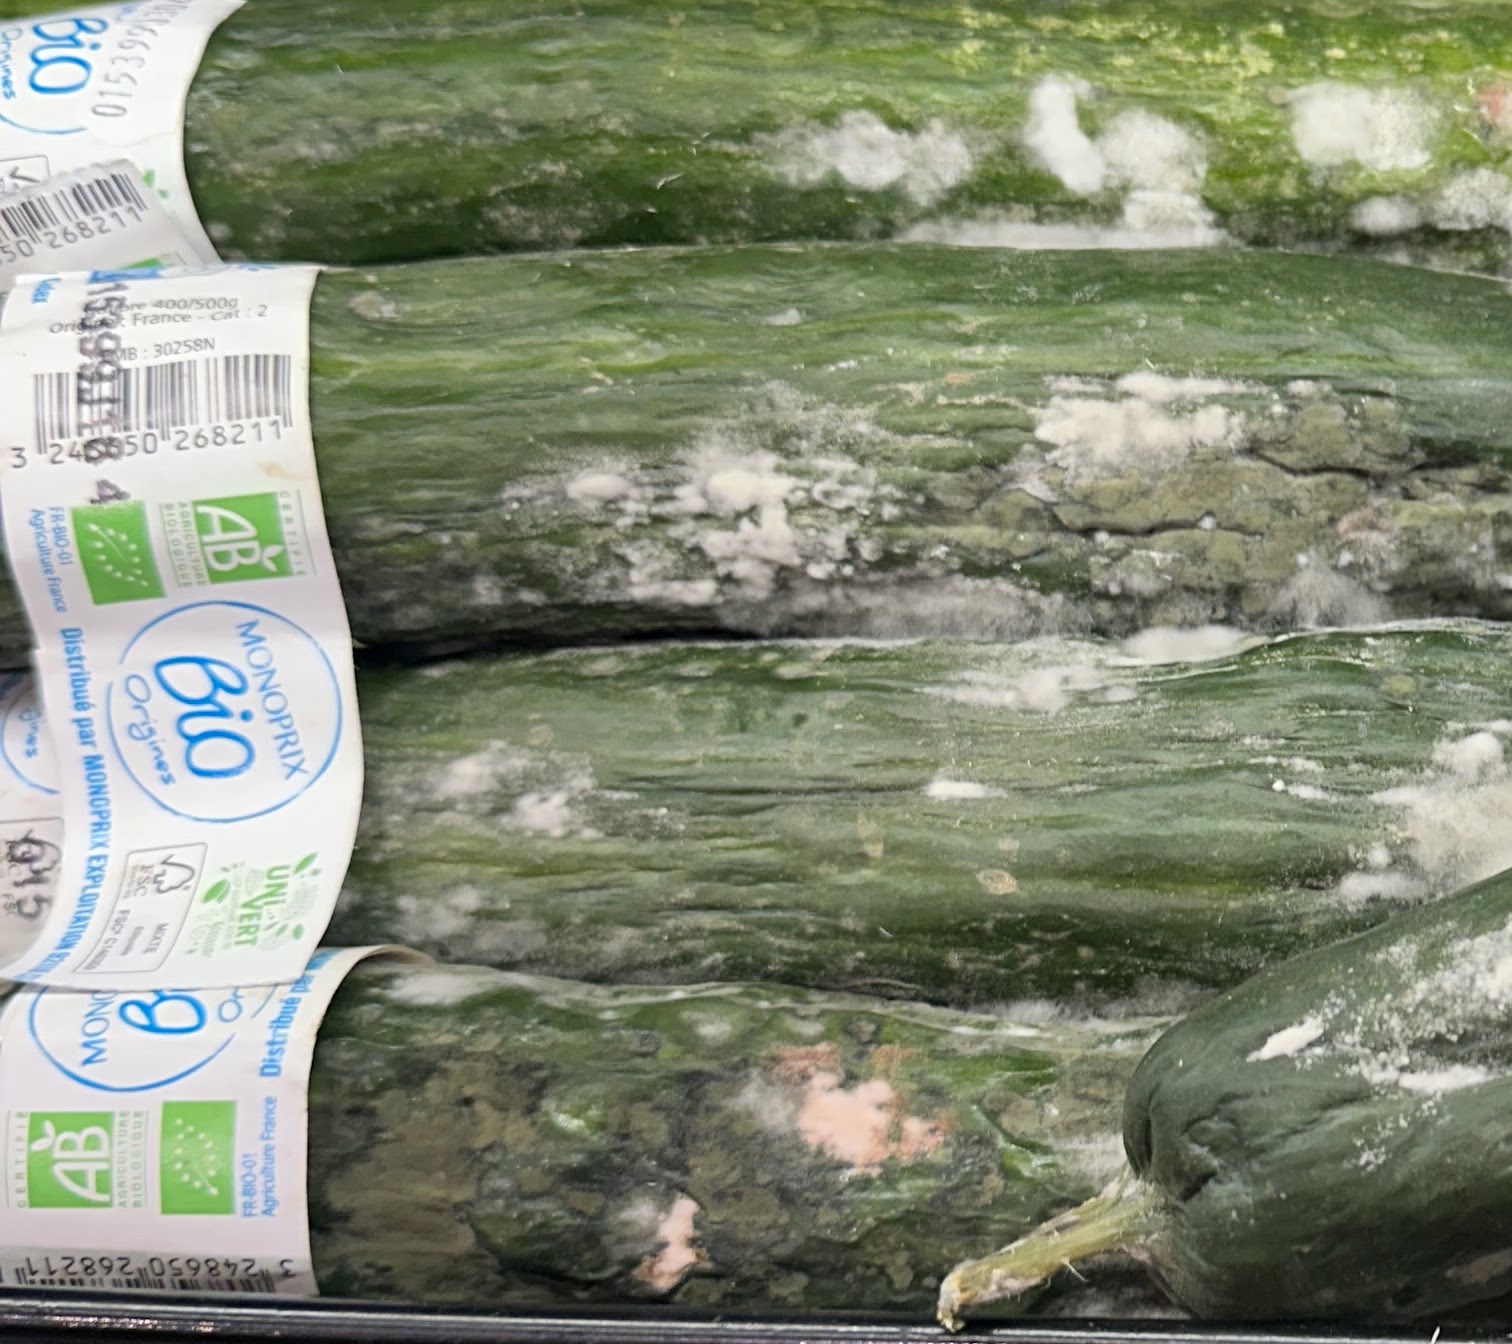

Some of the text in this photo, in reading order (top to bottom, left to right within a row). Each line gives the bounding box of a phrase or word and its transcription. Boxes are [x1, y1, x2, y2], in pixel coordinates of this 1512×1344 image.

[44, 206, 142, 249] 268211
[131, 312, 193, 327] France
[10, 447, 27, 469] 3
[175, 420, 283, 452] 268211
[28, 509, 58, 575] Agriculture
[195, 504, 261, 571] AB
[59, 627, 96, 712] Distribué
[236, 619, 309, 780] MONOPRIX
[74, 716, 99, 747] par
[125, 674, 176, 786] Origines
[154, 656, 256, 778] Bio
[82, 753, 113, 851] MONOPRIX
[56, 854, 110, 950] EXPLOITATION
[234, 896, 268, 947] VERT
[259, 997, 303, 1078] Distribué
[51, 1125, 110, 1202] AB
[262, 1096, 280, 1217] Agriculture France
[25, 1255, 131, 1277] 268211
